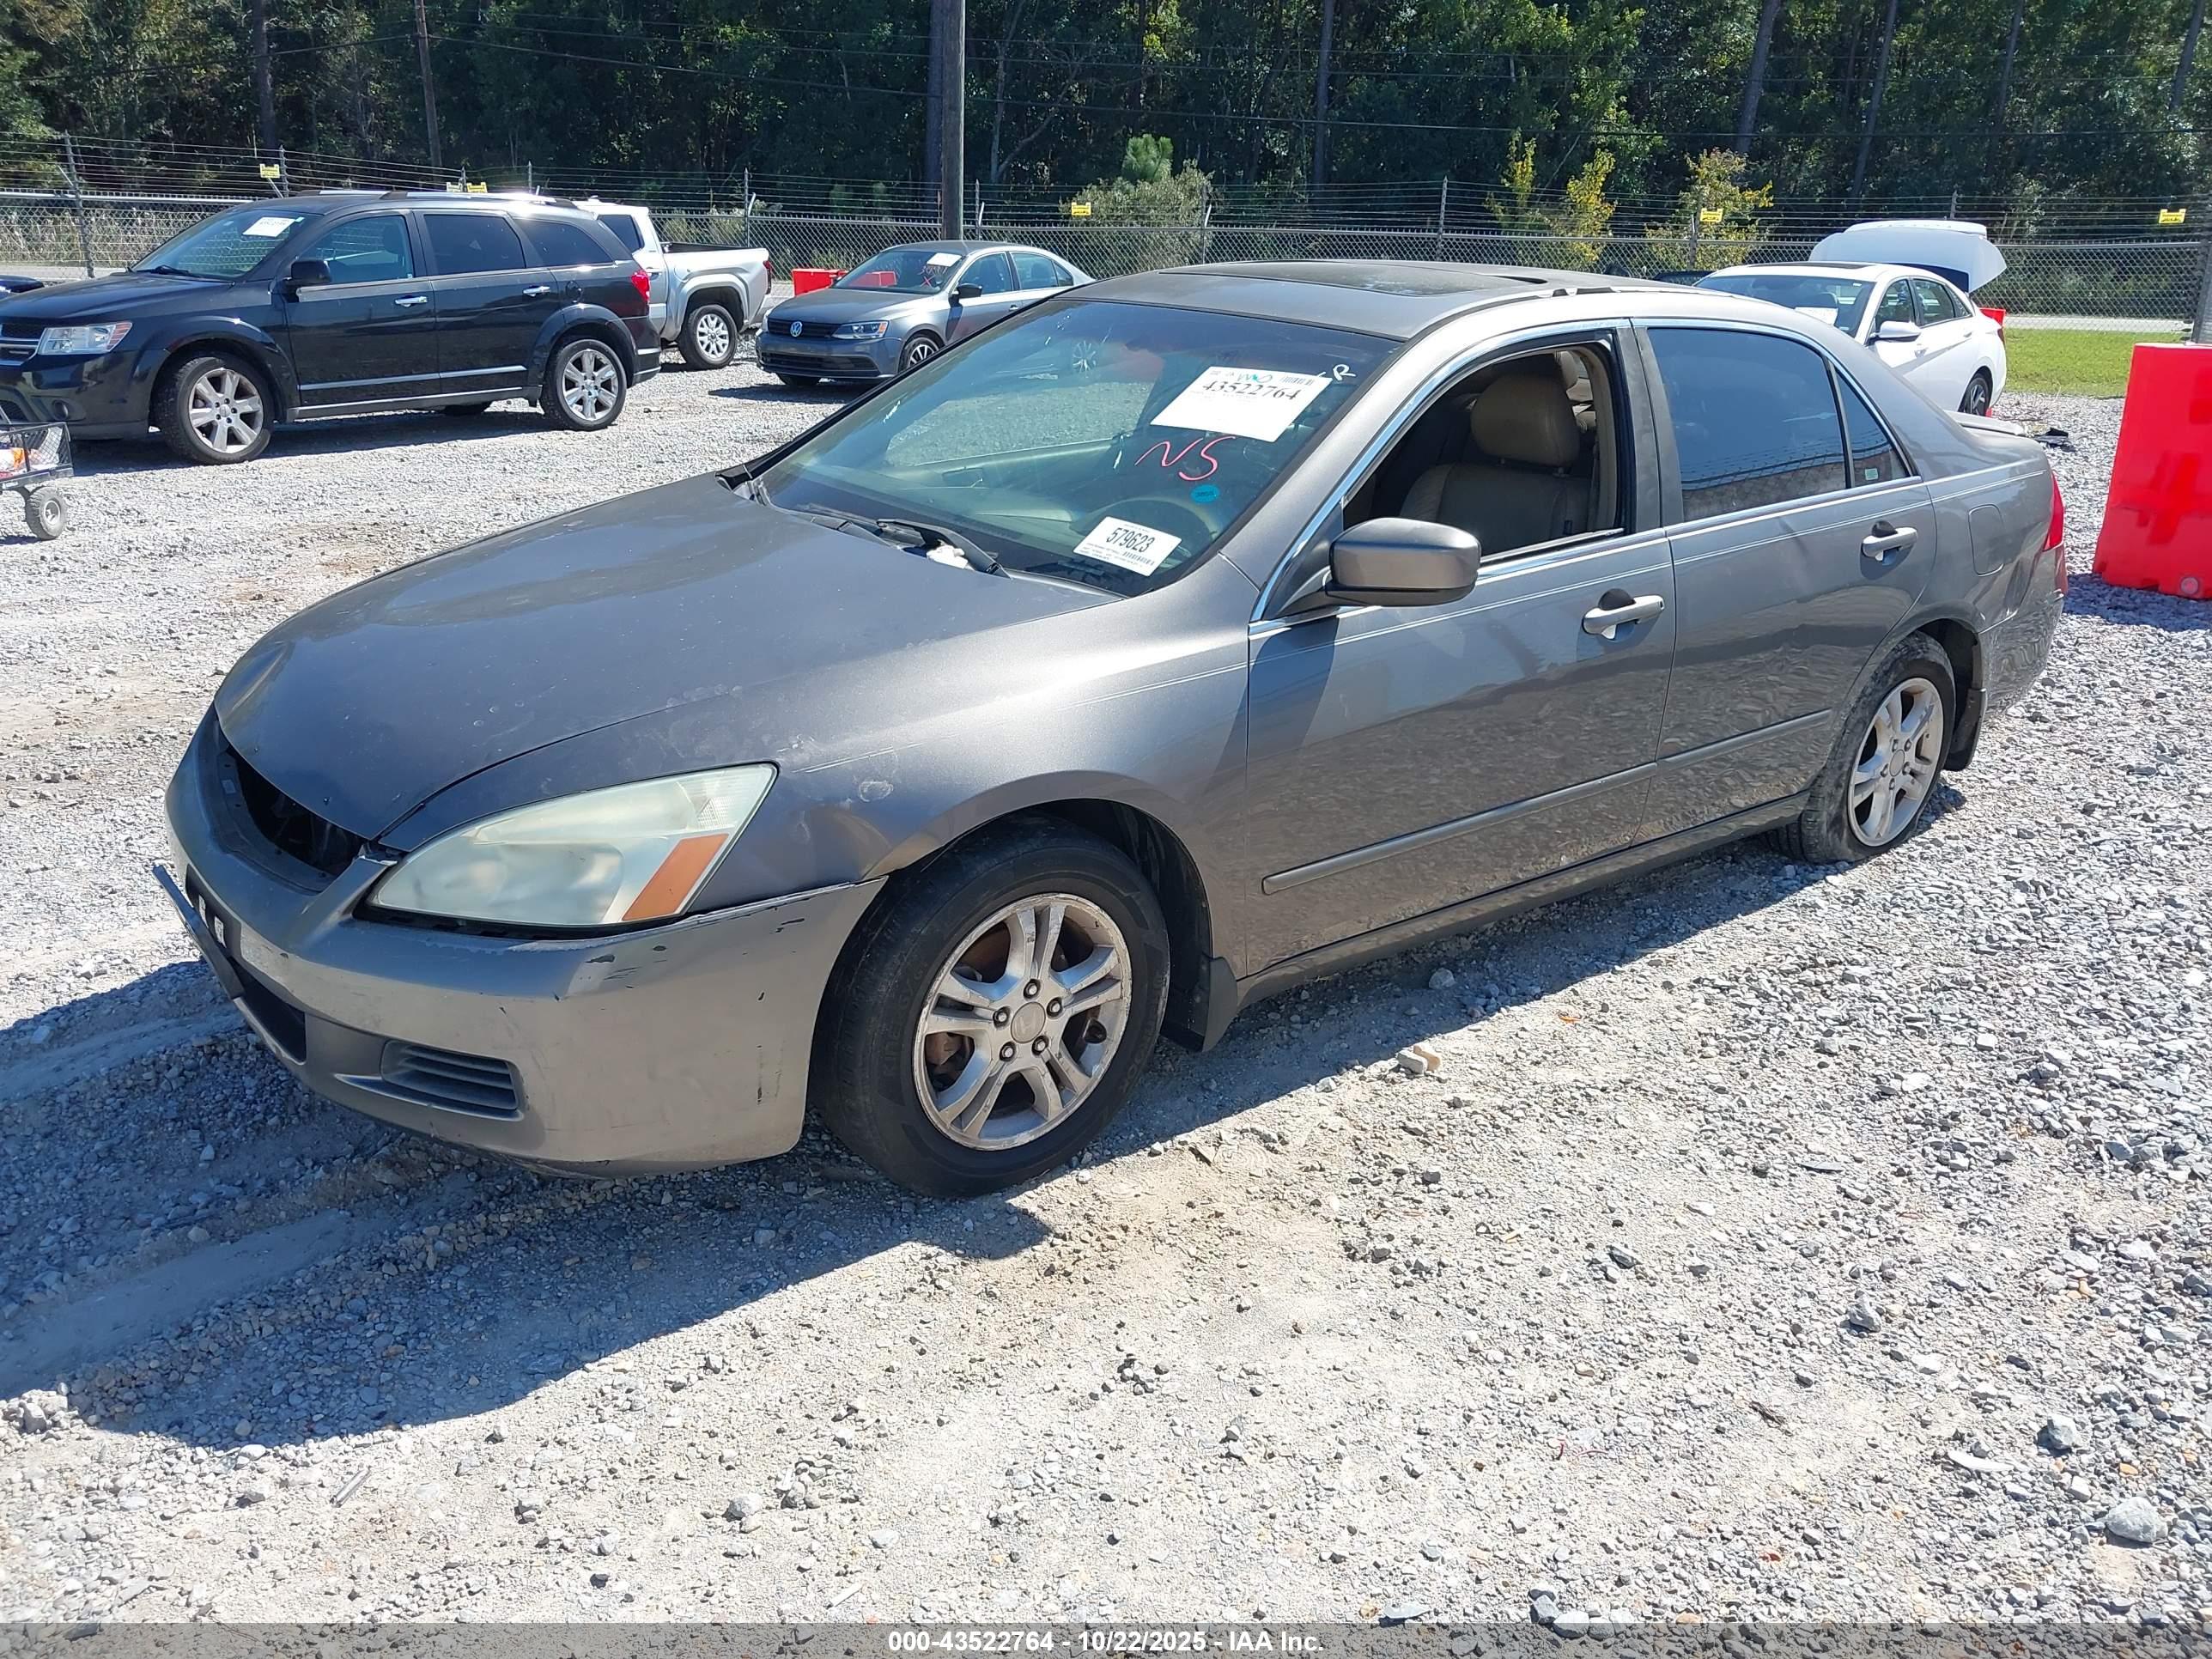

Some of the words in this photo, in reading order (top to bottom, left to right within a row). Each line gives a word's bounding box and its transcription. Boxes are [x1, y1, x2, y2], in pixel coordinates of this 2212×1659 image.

[1202, 380, 1302, 400] 43522764
[1133, 435, 1236, 481] NS
[1106, 527, 1156, 553] 579623
